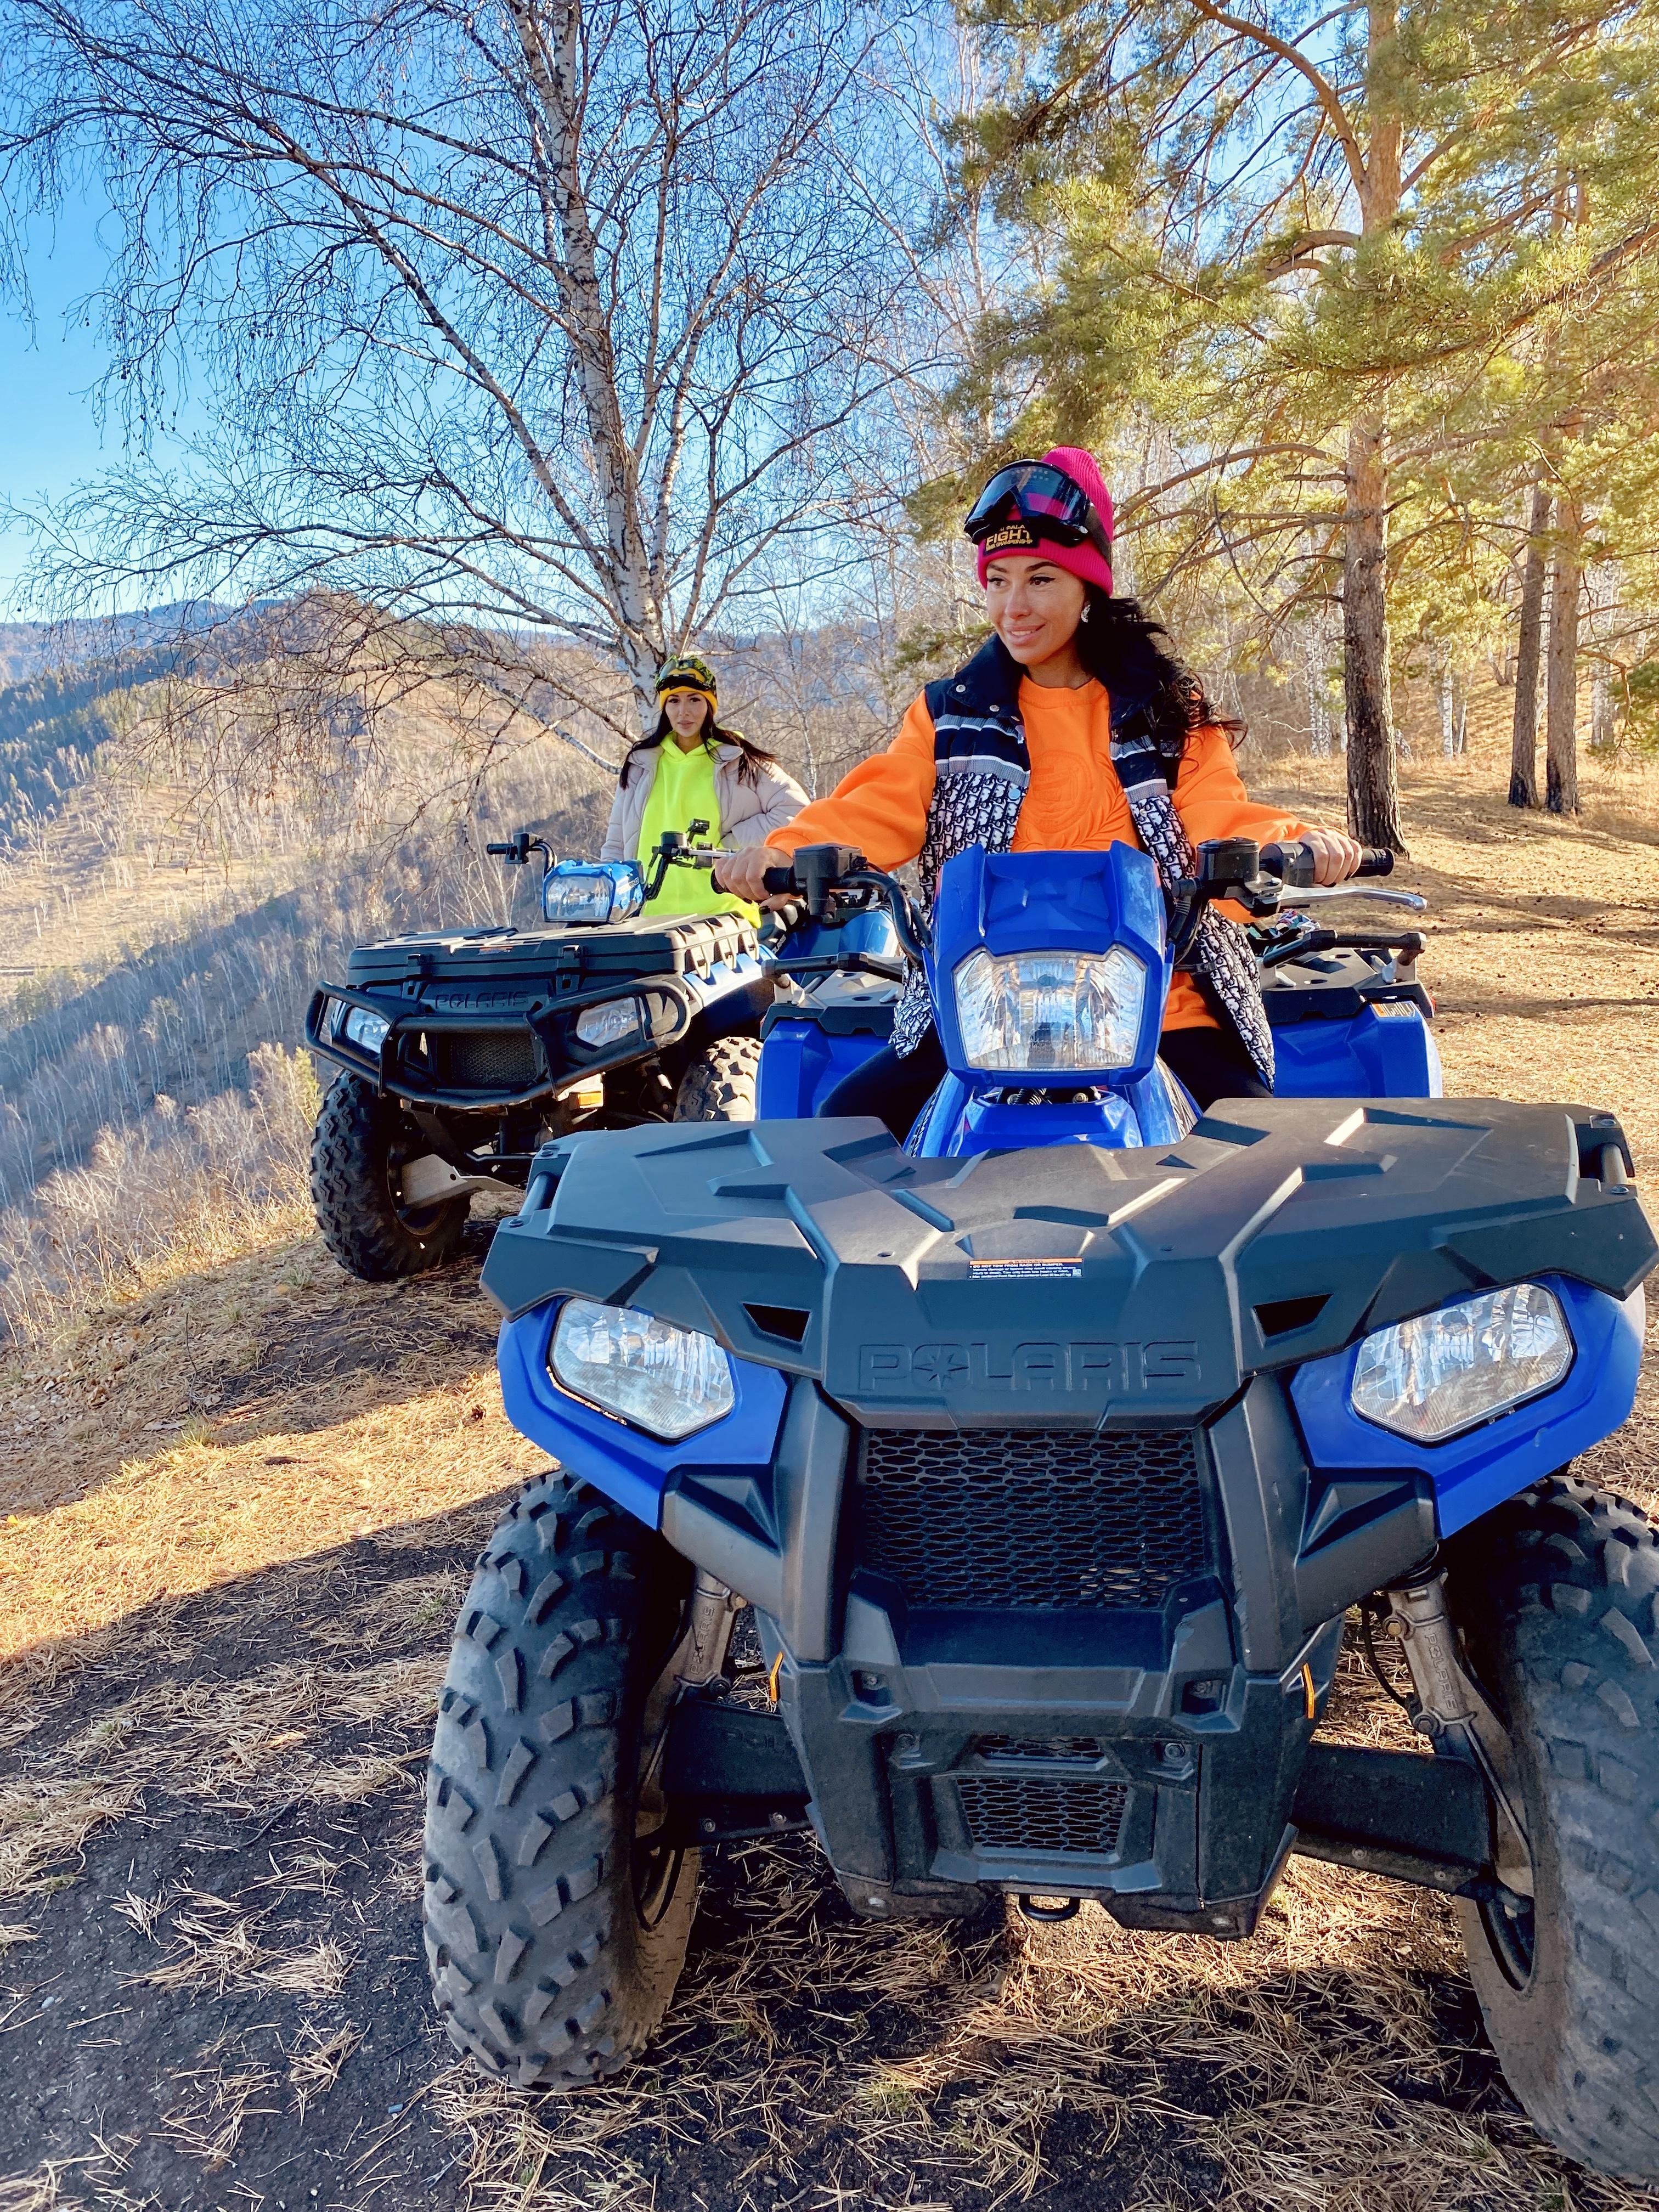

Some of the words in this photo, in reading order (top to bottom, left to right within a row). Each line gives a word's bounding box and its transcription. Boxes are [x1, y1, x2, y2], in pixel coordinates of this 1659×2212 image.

[435, 991, 531, 1009] POLARIS
[858, 1340, 1201, 1392] POLARIS
[1424, 1633, 1458, 1710] POLARIS
